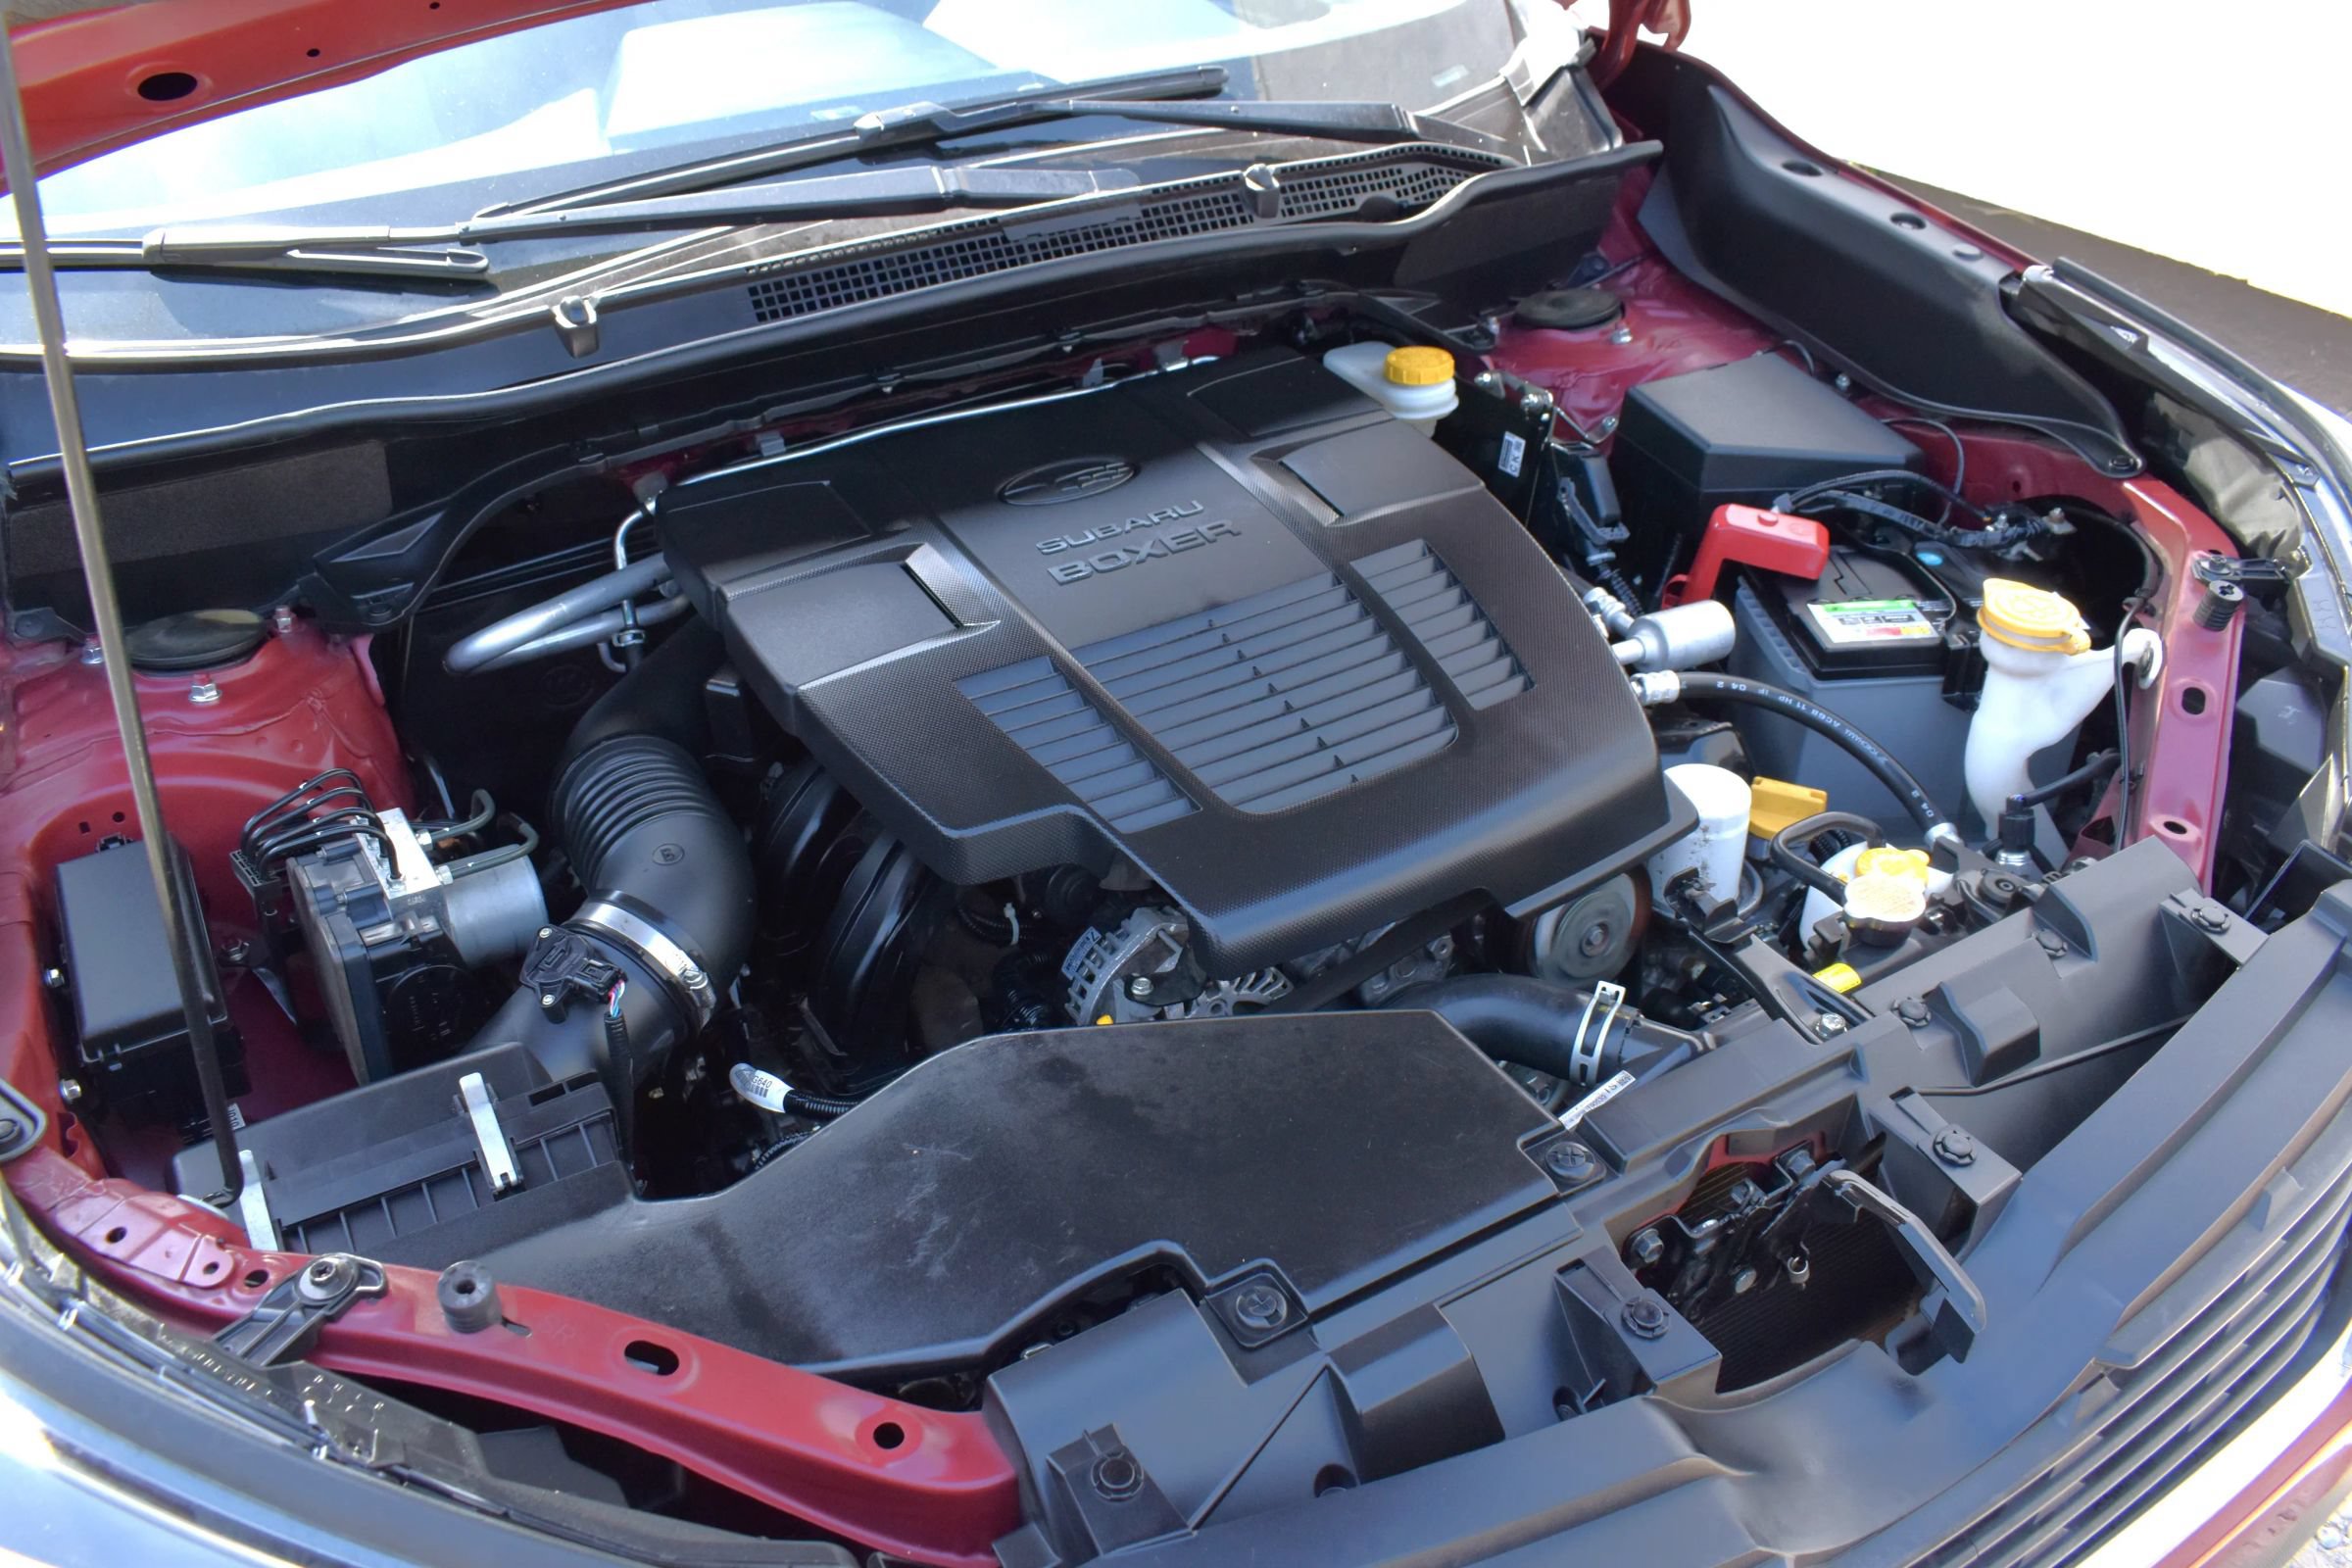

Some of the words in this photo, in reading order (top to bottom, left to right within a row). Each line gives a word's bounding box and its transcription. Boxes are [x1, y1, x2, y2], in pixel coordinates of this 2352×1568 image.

[1035, 500, 1204, 555] SUBARU
[1047, 518, 1242, 586] BOXER
[1779, 695, 1793, 705] HP
[660, 848, 675, 862] B
